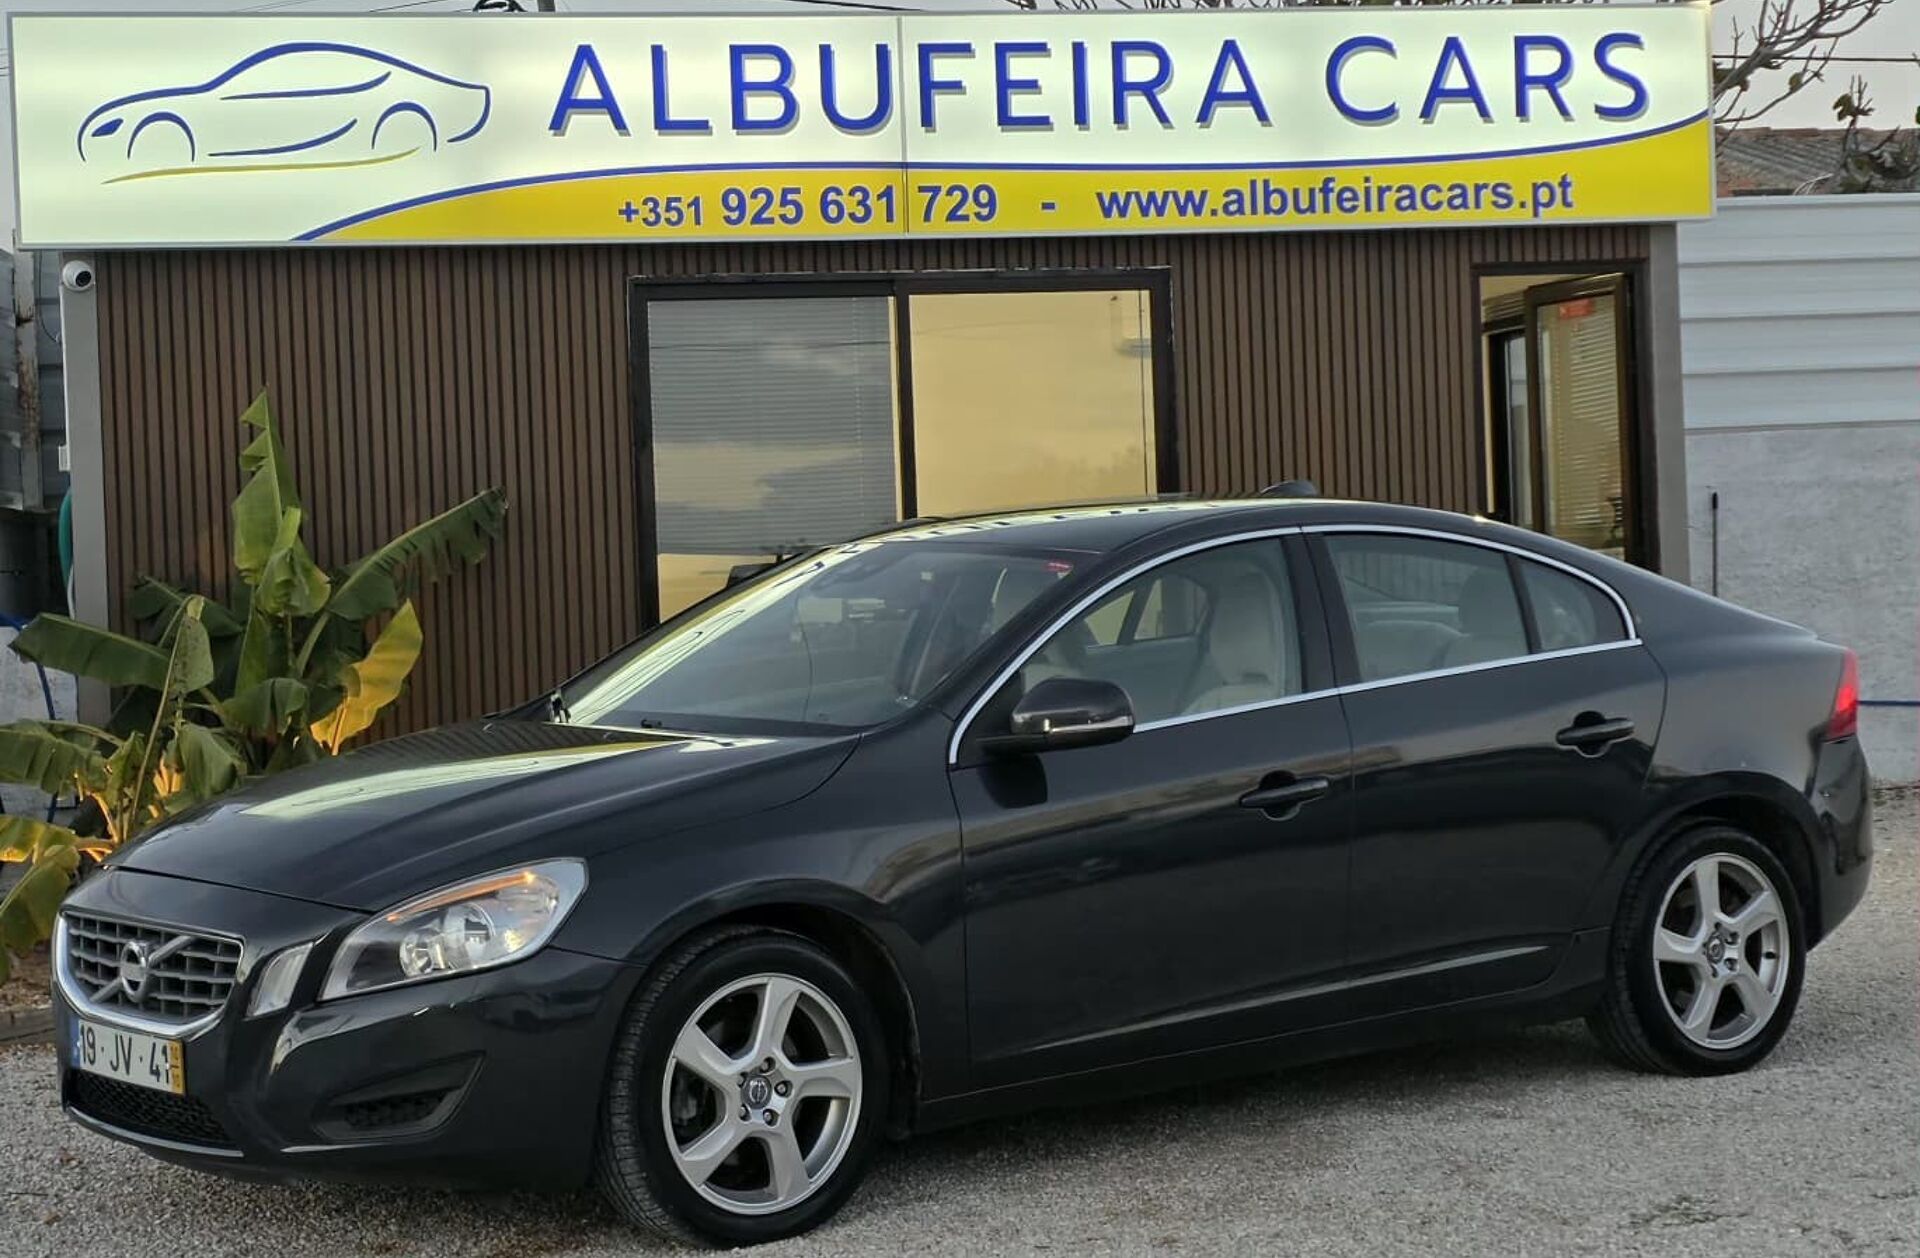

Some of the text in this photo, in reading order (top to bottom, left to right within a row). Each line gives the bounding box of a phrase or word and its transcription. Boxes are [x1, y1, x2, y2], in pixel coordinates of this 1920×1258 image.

[549, 33, 1651, 134] ALBUFEIRA CARS
[618, 196, 703, 226] +351
[722, 187, 804, 225] 925
[821, 187, 895, 224] 631
[918, 185, 997, 222] 729
[1096, 173, 1574, 218] www.albufeiracars.pt
